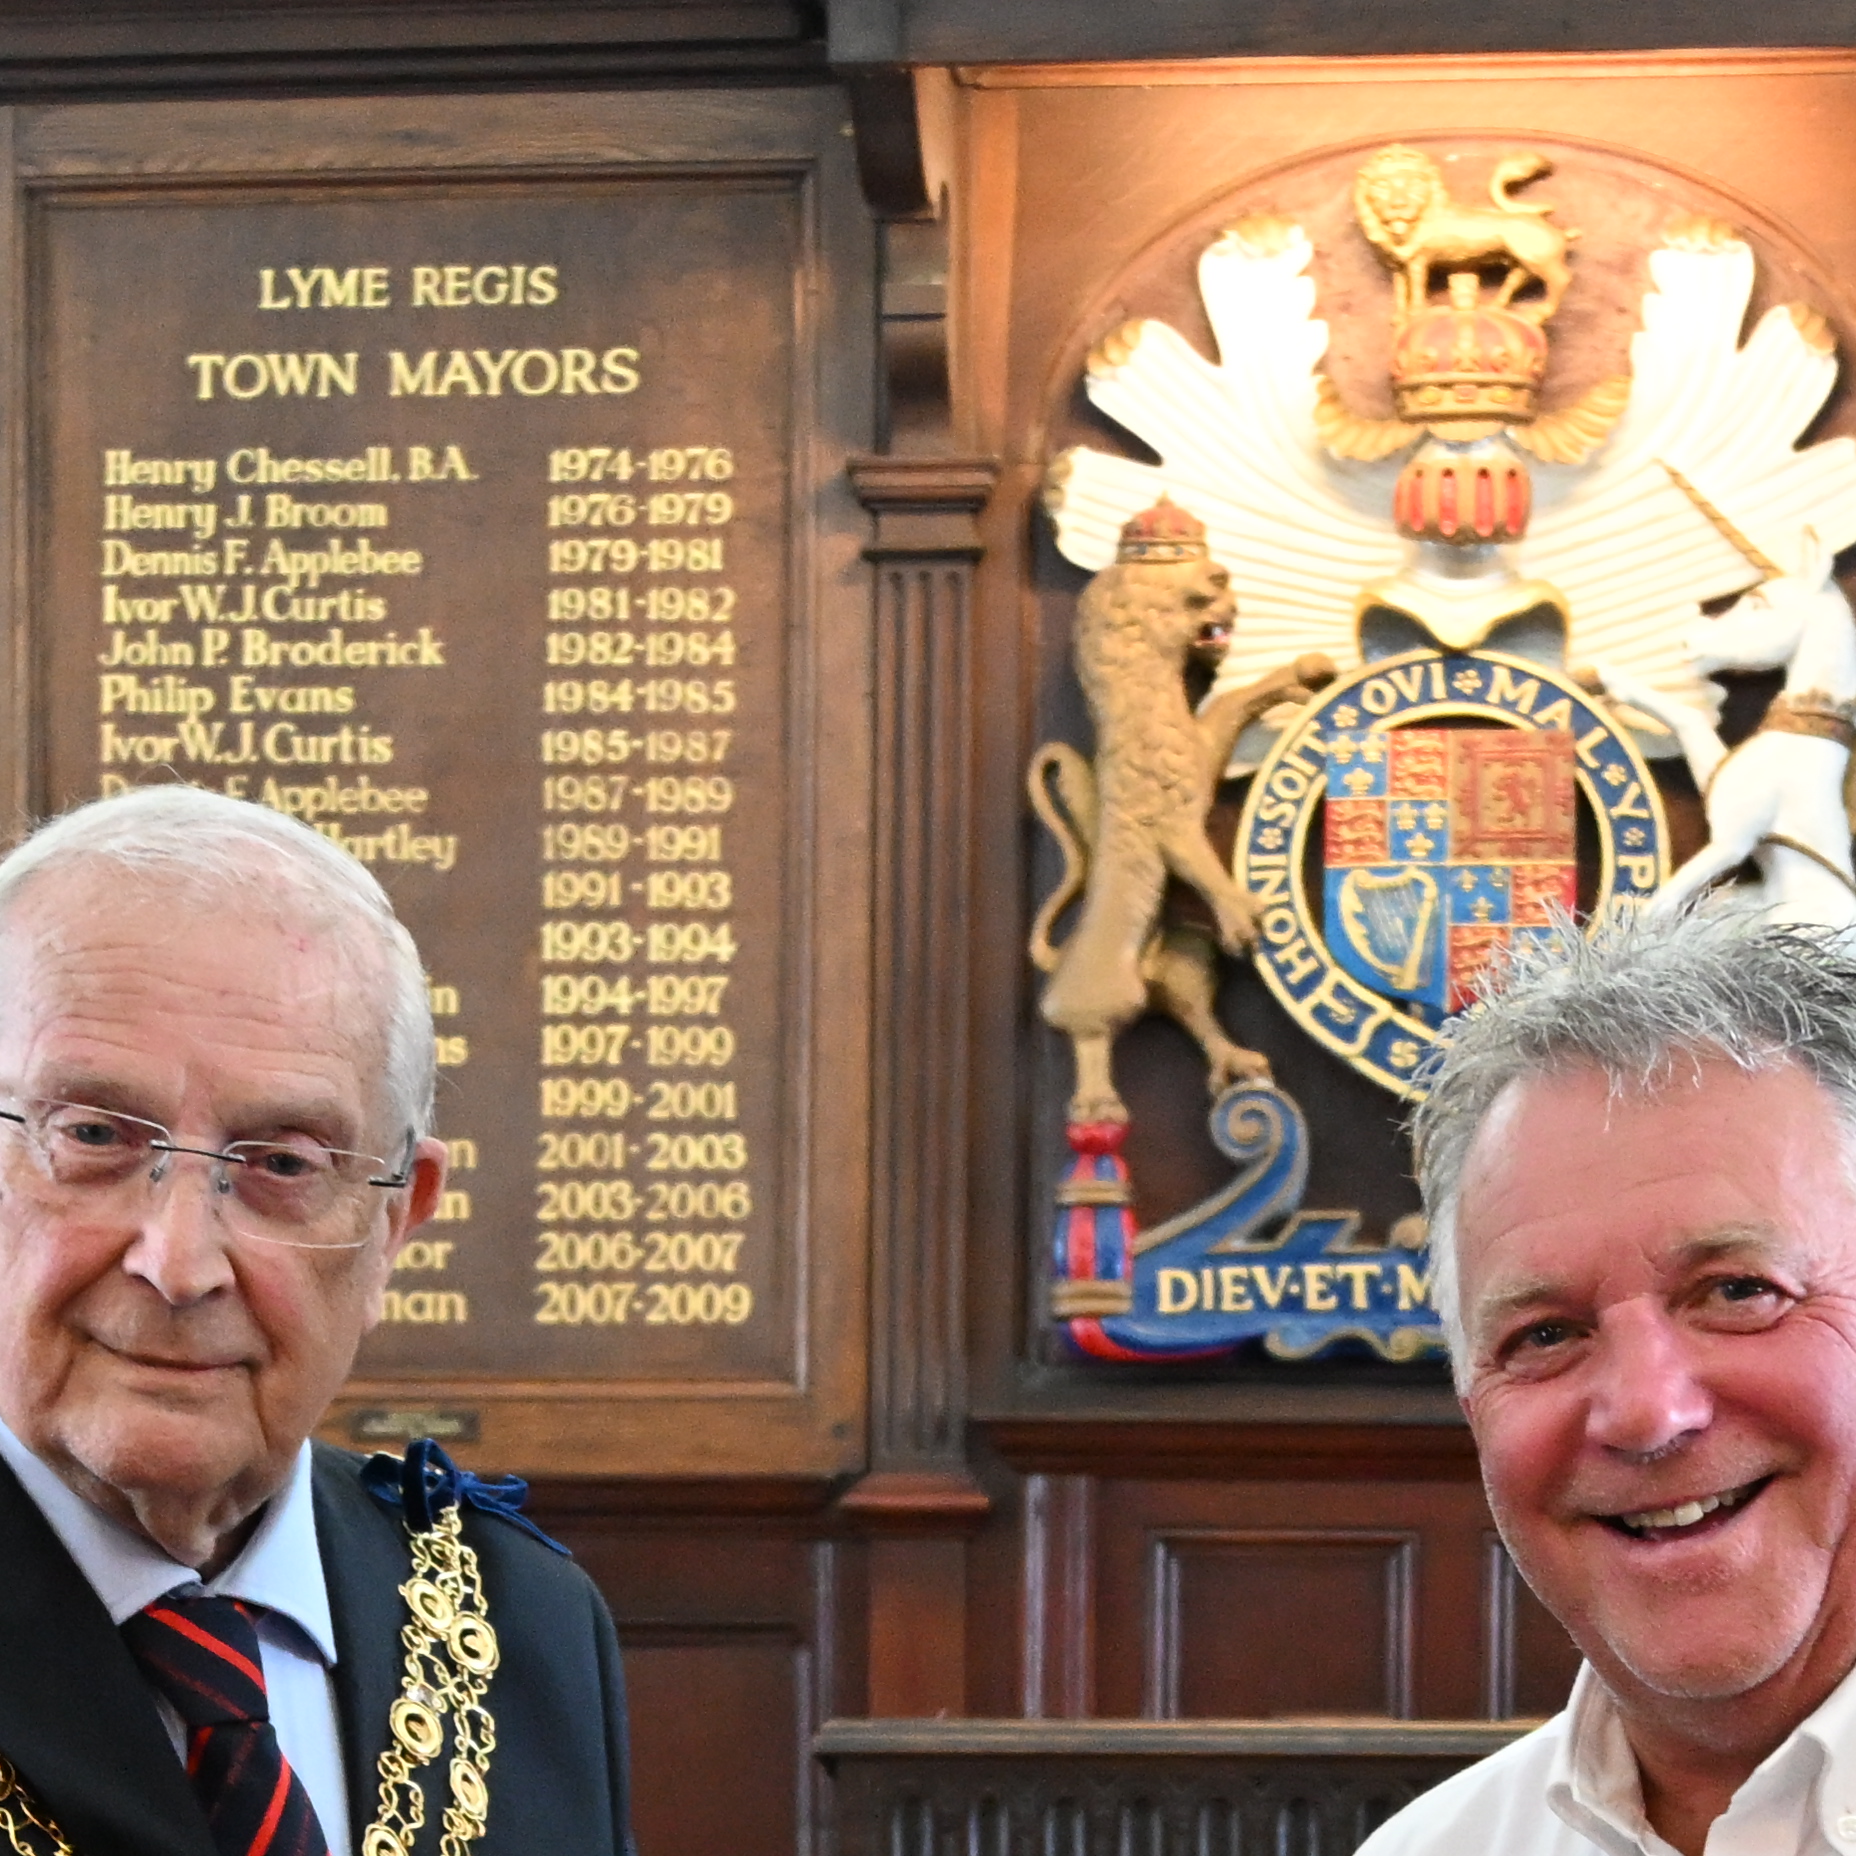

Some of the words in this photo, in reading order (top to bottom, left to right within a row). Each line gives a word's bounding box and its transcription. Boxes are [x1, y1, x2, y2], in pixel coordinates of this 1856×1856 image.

[258, 268, 388, 310] LYME
[412, 266, 558, 307] REGIS
[188, 352, 357, 400] TOWN
[389, 348, 640, 398] MAYORS
[104, 449, 217, 493] Henry
[104, 494, 217, 539] Henry
[265, 493, 388, 529] Broom
[101, 538, 218, 576] Dennis
[261, 537, 423, 588] Applebee
[261, 585, 388, 623] Curtis
[98, 629, 193, 667] John
[241, 628, 445, 667] Broderick
[99, 673, 215, 722] Philip
[229, 674, 356, 714] Evans
[1486, 665, 1610, 770] MAL
[264, 721, 393, 764] Curtis
[1259, 719, 1327, 828] SOIT
[263, 775, 429, 820] Applebee
[1609, 780, 1650, 819] Y
[1250, 854, 1318, 985] HONI
